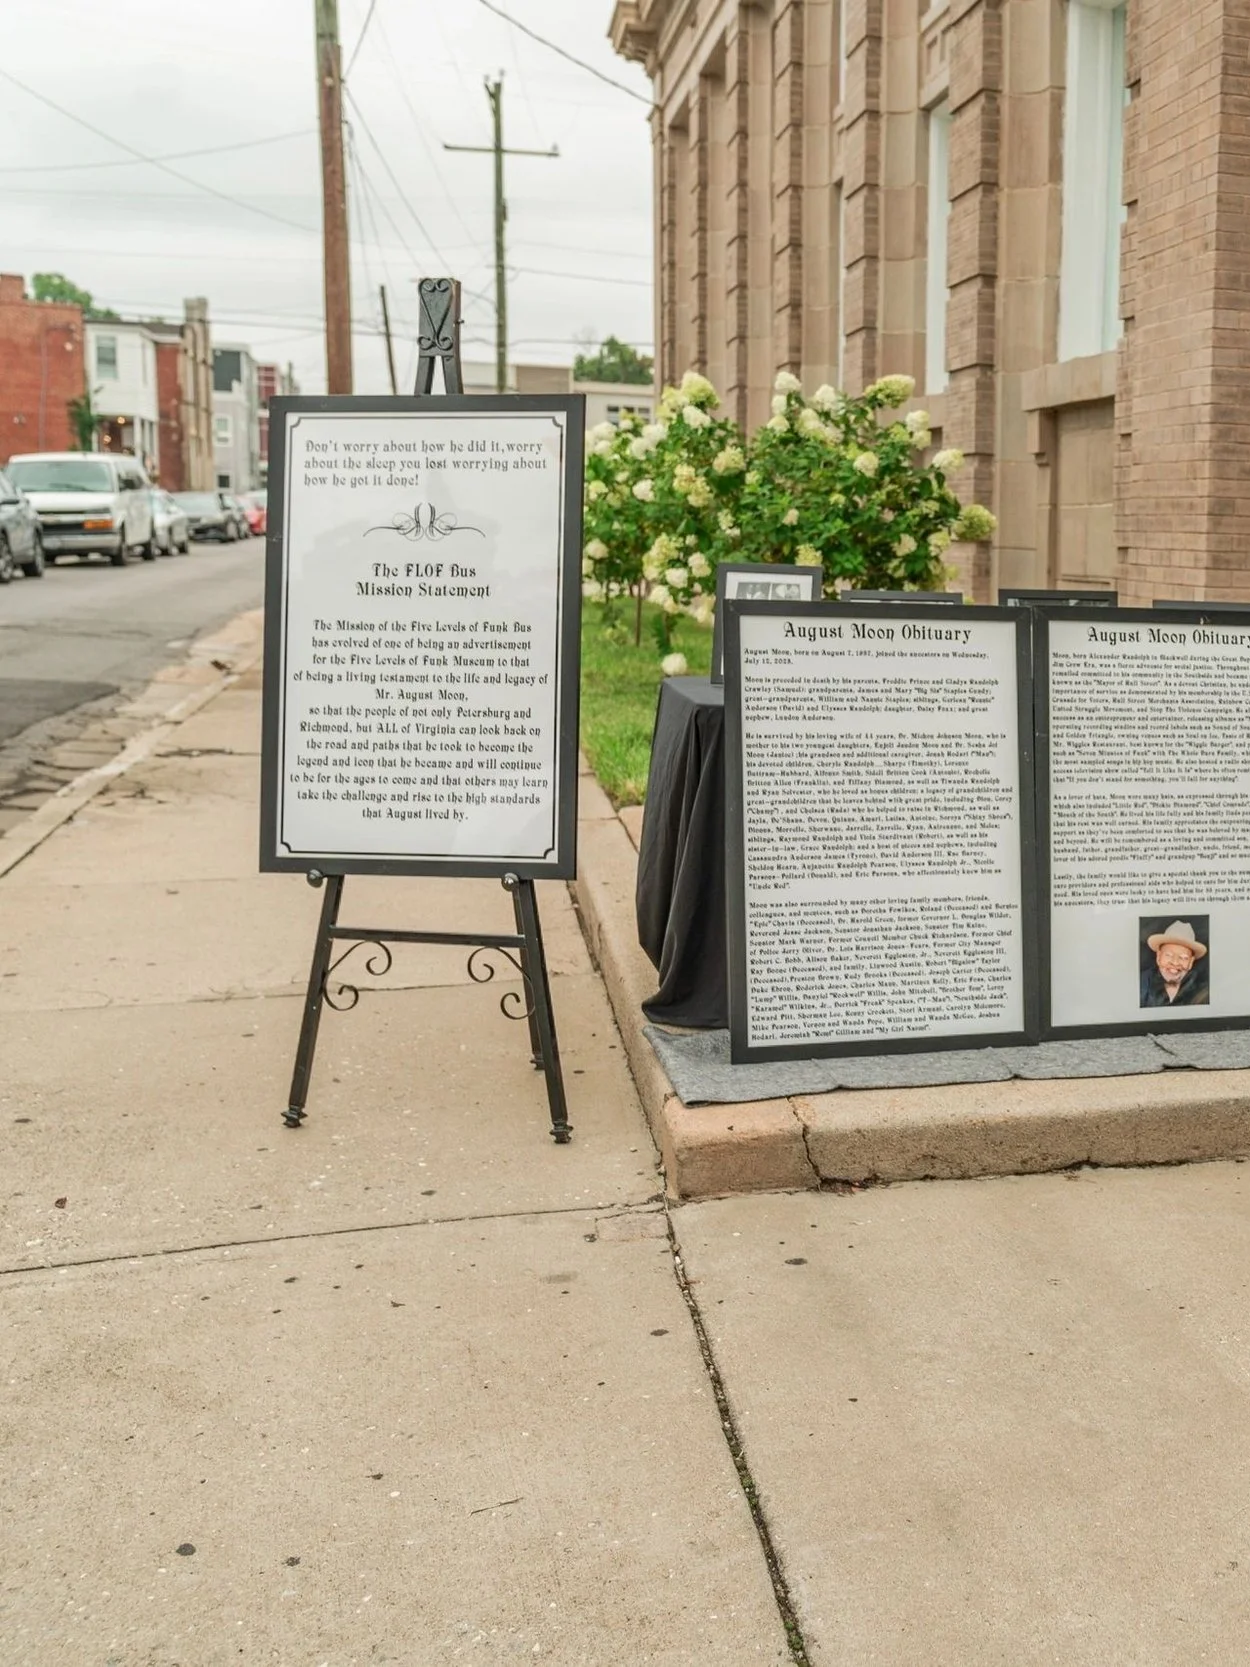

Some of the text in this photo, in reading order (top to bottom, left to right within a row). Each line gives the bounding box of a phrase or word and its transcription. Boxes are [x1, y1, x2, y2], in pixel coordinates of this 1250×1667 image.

[305, 440, 338, 452] Don't
[342, 443, 379, 455] worry
[382, 440, 417, 452] about
[421, 440, 446, 453] how
[449, 440, 464, 453] he
[467, 440, 486, 452] did
[506, 443, 543, 455] worry
[304, 456, 547, 472] about the sleep you lost worrying about
[303, 473, 419, 488] how he got it done!
[373, 563, 477, 578] The FLOF Bus
[357, 582, 490, 598] Mission Statement
[314, 619, 532, 633] The Mission of the Five Levels of Funk Bus
[783, 621, 972, 643] August Moon Obituary
[1087, 626, 1140, 646] August
[1147, 628, 1187, 645] Moon
[375, 688, 394, 699] Mr.
[397, 689, 433, 702] August
[299, 721, 541, 737] Richmond, but ALL of Virginia can look back on
[362, 807, 468, 822] that August lived by.
